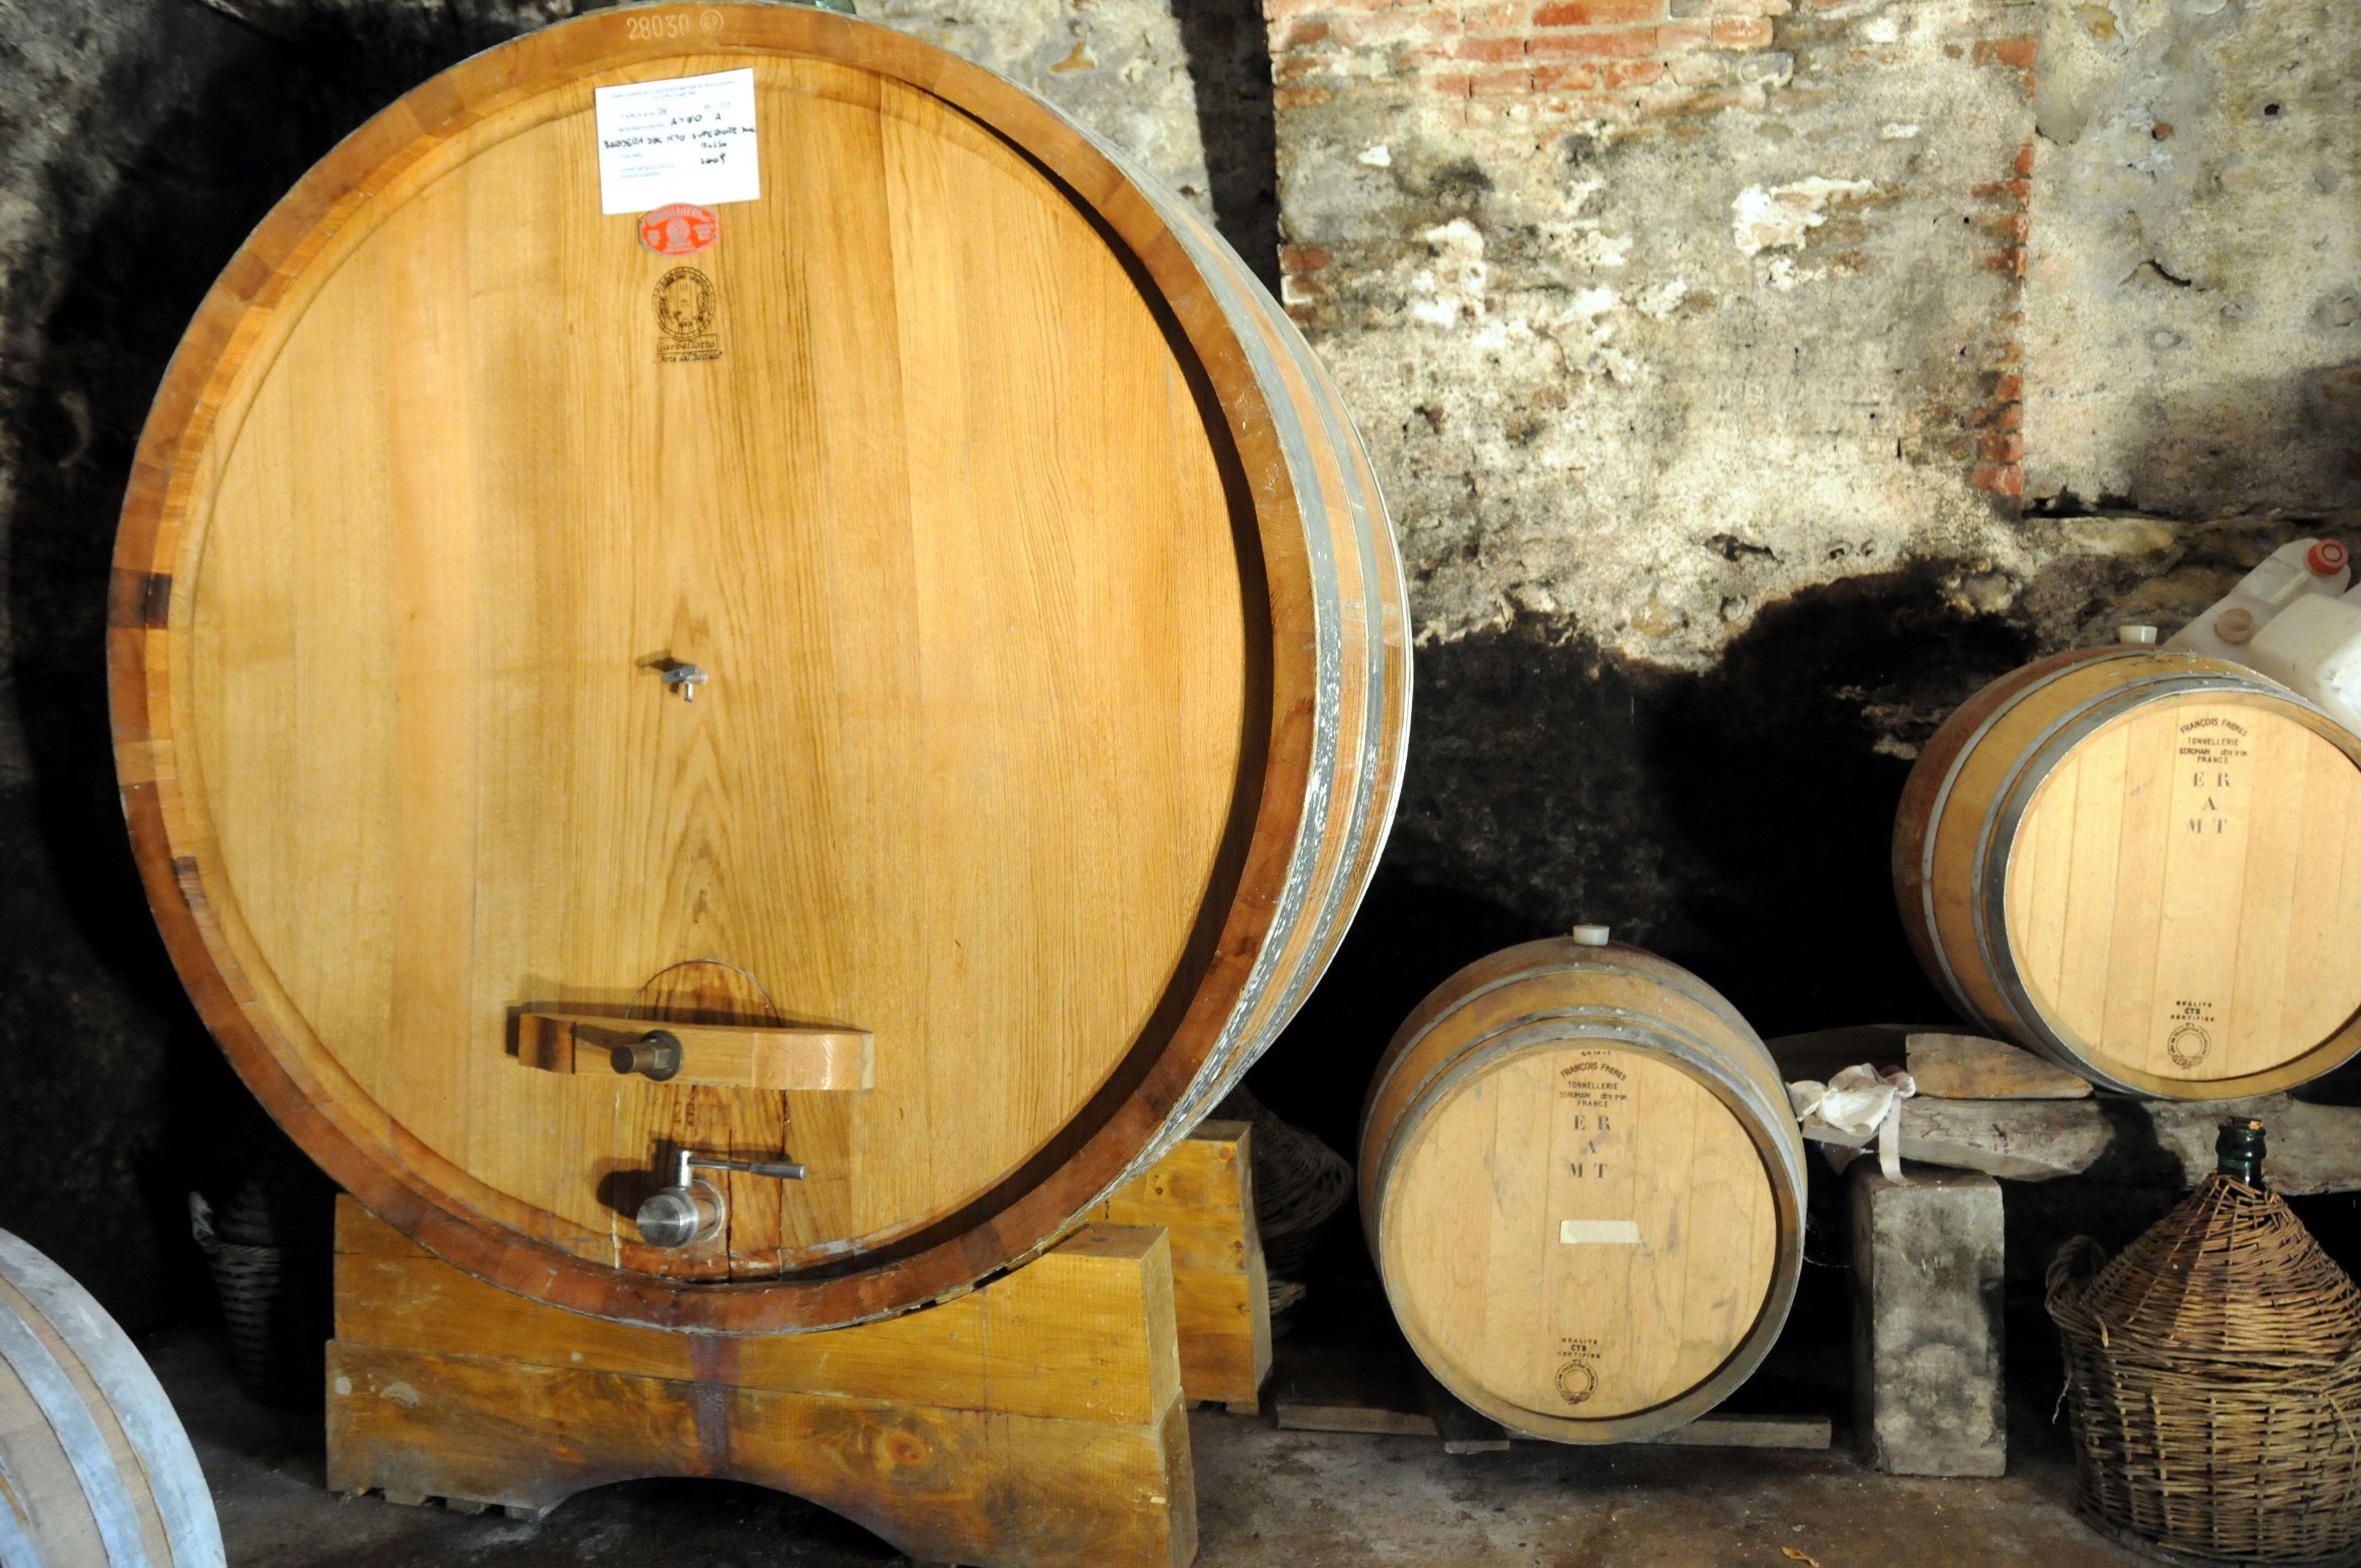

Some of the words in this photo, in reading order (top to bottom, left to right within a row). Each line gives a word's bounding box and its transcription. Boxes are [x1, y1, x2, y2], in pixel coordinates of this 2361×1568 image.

[626, 14, 690, 40] 28030
[2180, 718, 2218, 734] FRANÇOIS
[2188, 737, 2239, 746] TONNELLERIE
[2193, 771, 2205, 787] E
[2202, 796, 2217, 810] A
[2189, 818, 2202, 833] M
[2213, 818, 2228, 834] T
[1560, 1062, 1597, 1078] FRANÇOIS
[1568, 1081, 1618, 1090] TONNELLERIE
[1574, 1115, 1586, 1130] E
[1586, 1140, 1597, 1154] A
[1569, 1163, 1583, 1178] M
[1594, 1163, 1608, 1178] T
